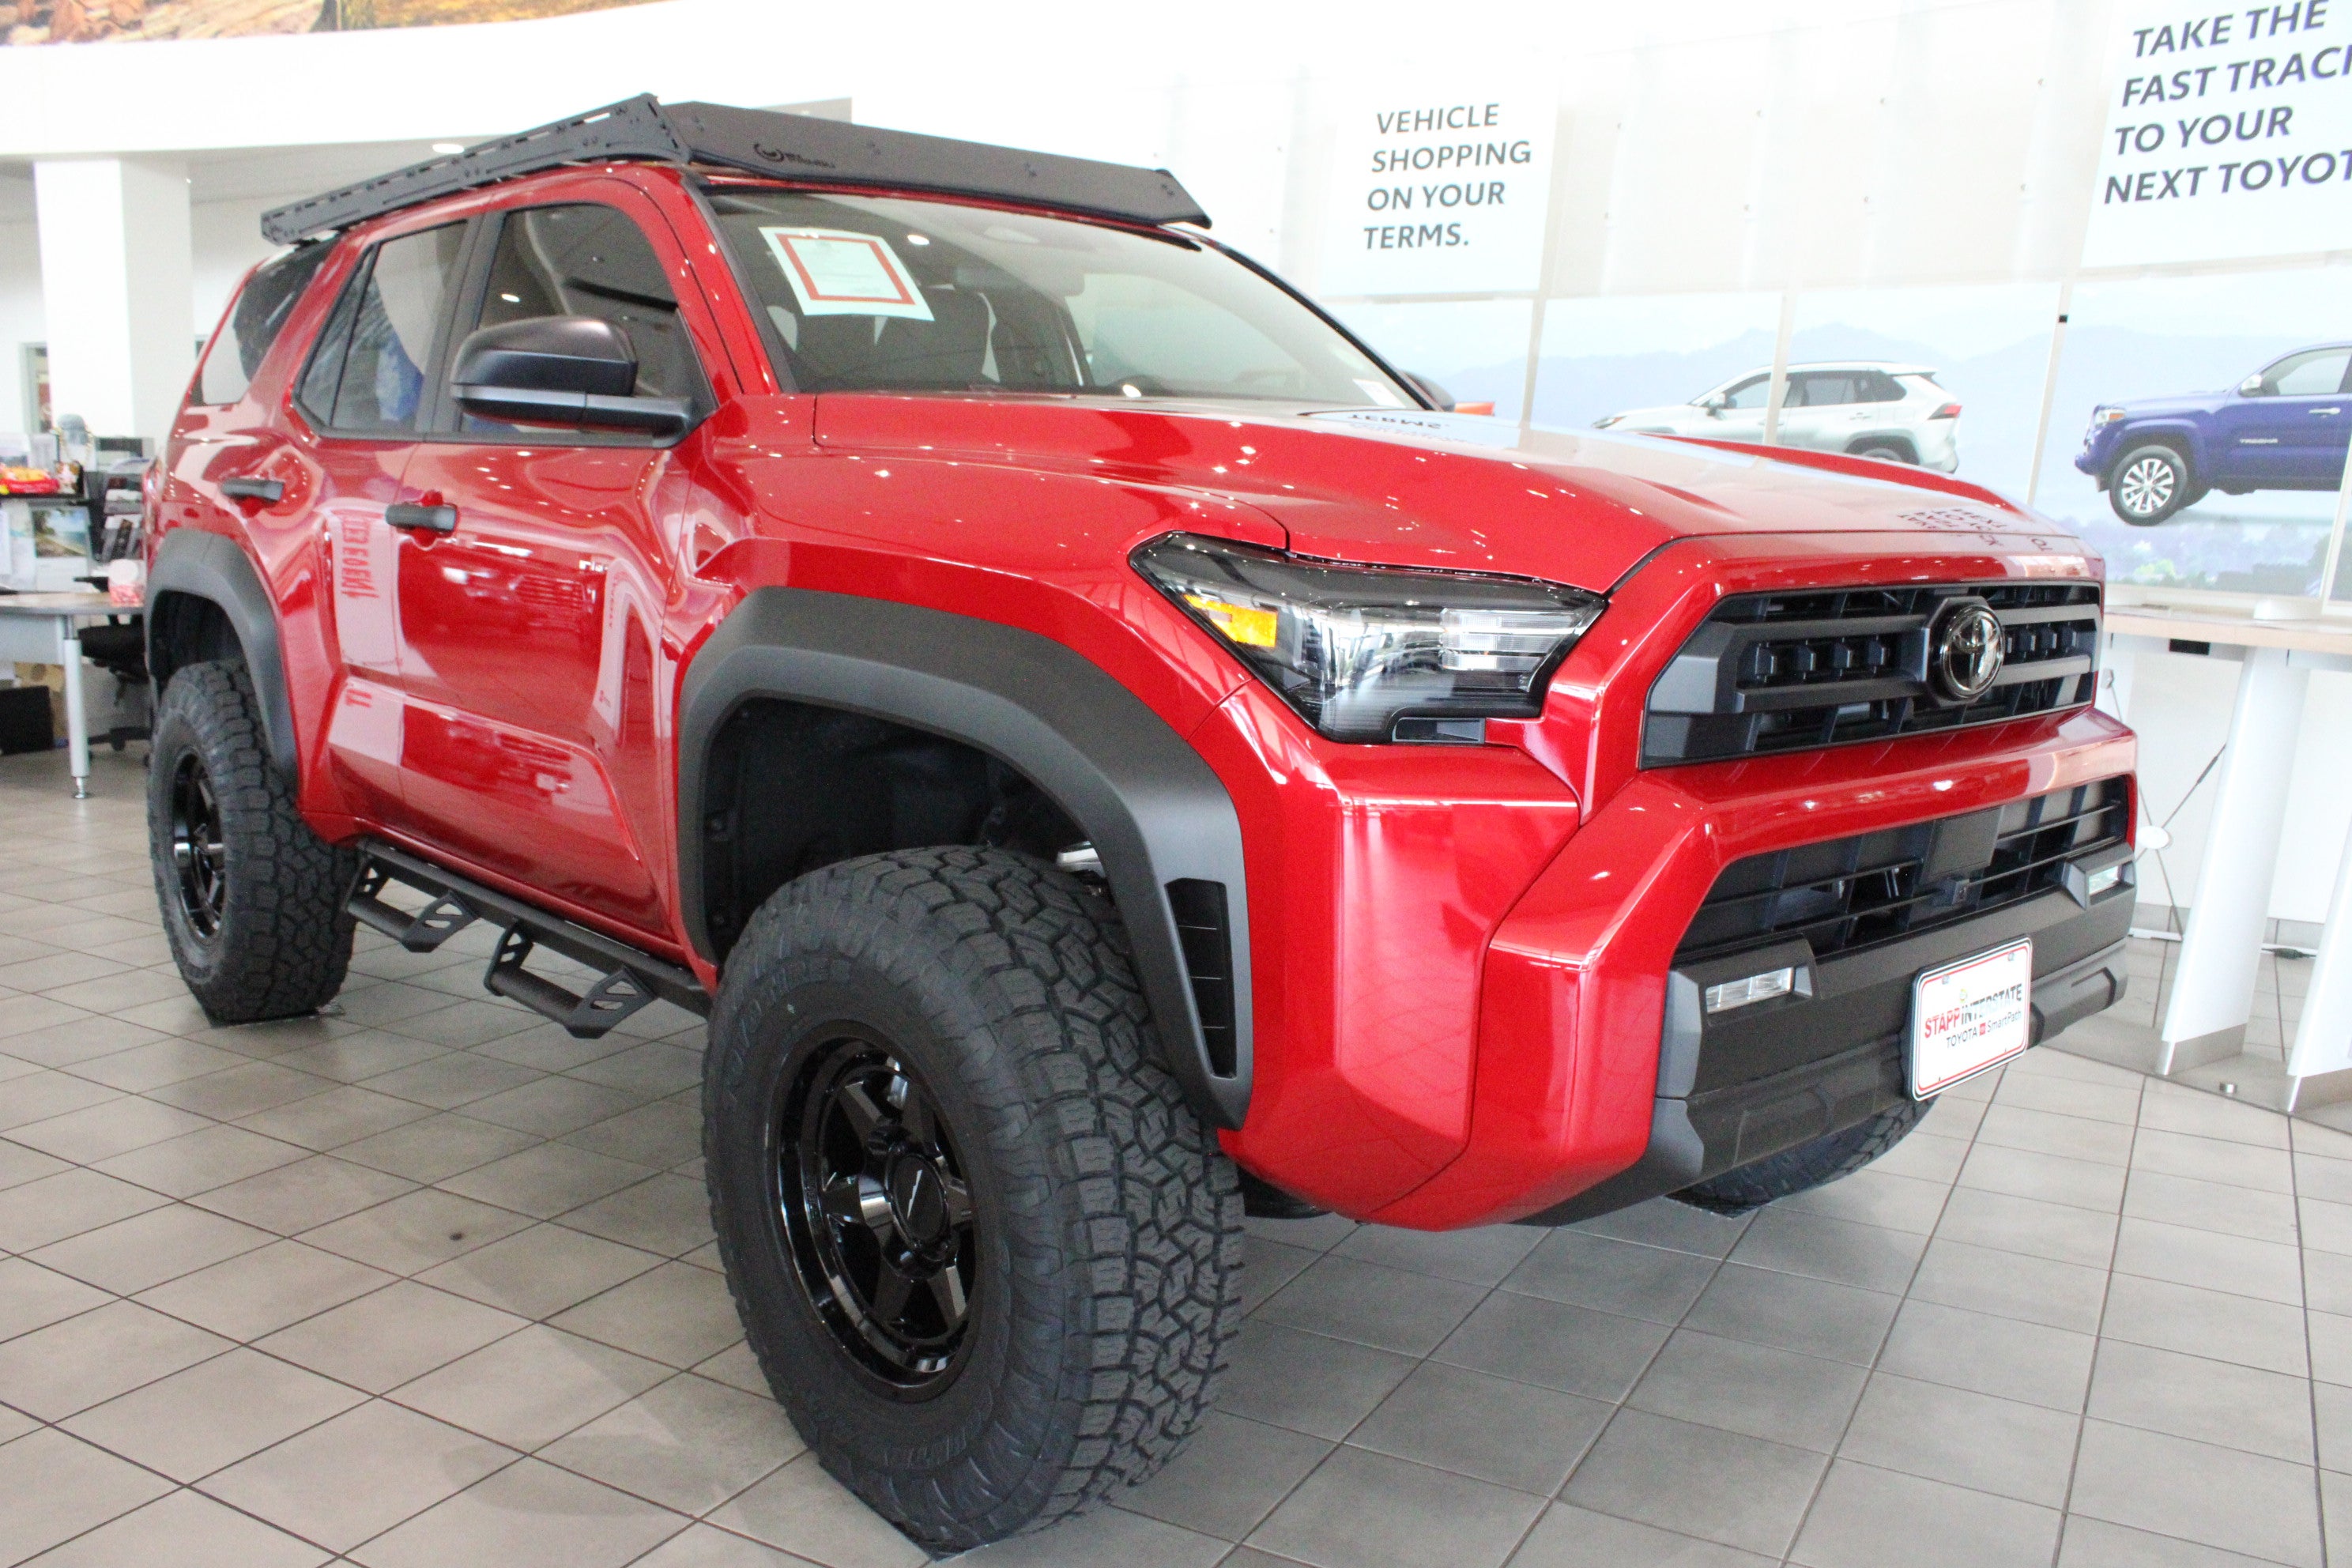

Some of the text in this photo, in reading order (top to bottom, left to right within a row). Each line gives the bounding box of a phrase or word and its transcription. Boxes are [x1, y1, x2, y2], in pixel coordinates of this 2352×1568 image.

[2133, 0, 2329, 58] TAKE THE
[2122, 66, 2218, 107] FAST
[1376, 103, 1500, 134] VEHICLE
[2115, 105, 2294, 156] TO YOUR
[1371, 140, 1532, 173] SHOPPING
[1366, 181, 1506, 211] ON YOUR
[2104, 165, 2210, 205] NEXT
[1363, 222, 1470, 250] TERMS.
[1924, 1007, 1961, 1039] STAPP
[1946, 1011, 2022, 1049] TOYOTA SmartPath
